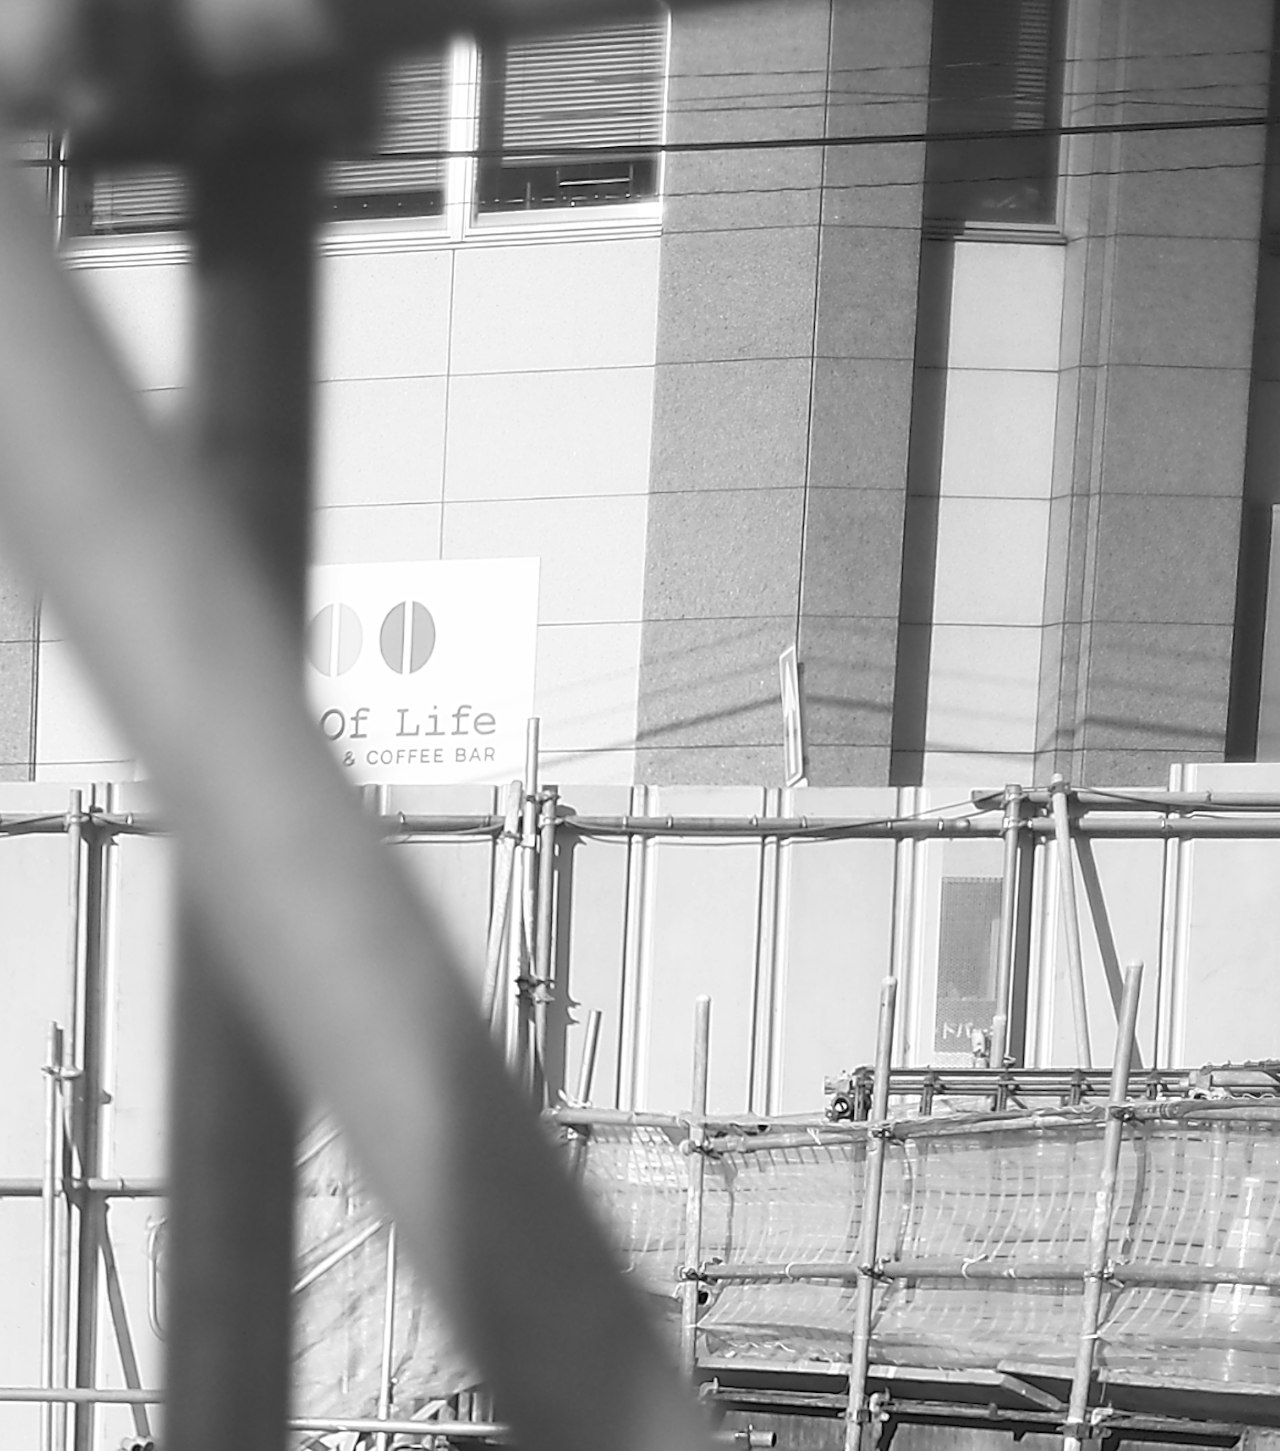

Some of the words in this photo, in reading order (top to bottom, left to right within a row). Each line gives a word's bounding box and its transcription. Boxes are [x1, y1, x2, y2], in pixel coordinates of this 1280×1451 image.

[319, 707, 371, 741] Of
[395, 703, 496, 737] Life
[343, 750, 356, 767] &
[366, 749, 444, 765] COFFEE
[455, 746, 495, 763] BAR
